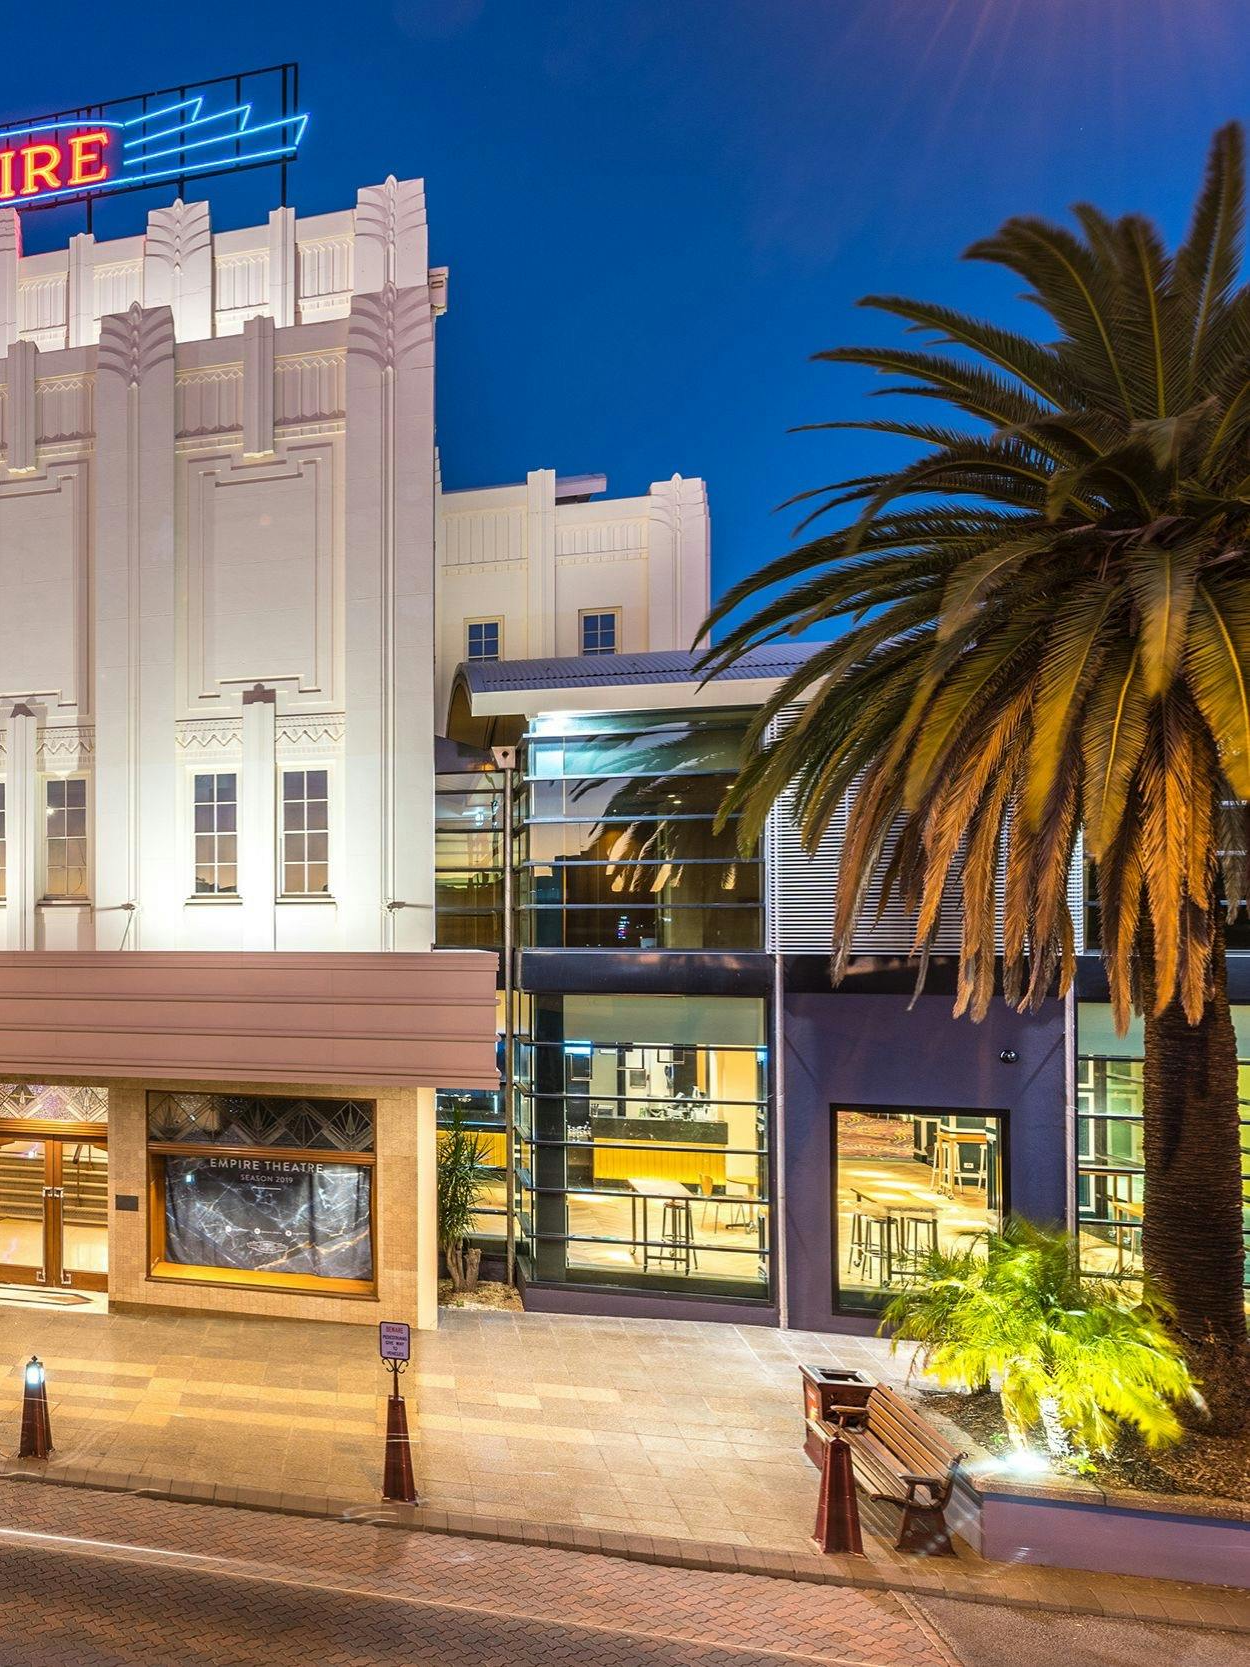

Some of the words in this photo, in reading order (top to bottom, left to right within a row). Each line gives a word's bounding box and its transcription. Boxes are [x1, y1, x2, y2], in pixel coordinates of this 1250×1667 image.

[210, 1158, 260, 1171] EMPIRE
[264, 1161, 324, 1174] THEATRE
[240, 1174, 273, 1182] SEASON
[275, 1176, 294, 1184] 2019
